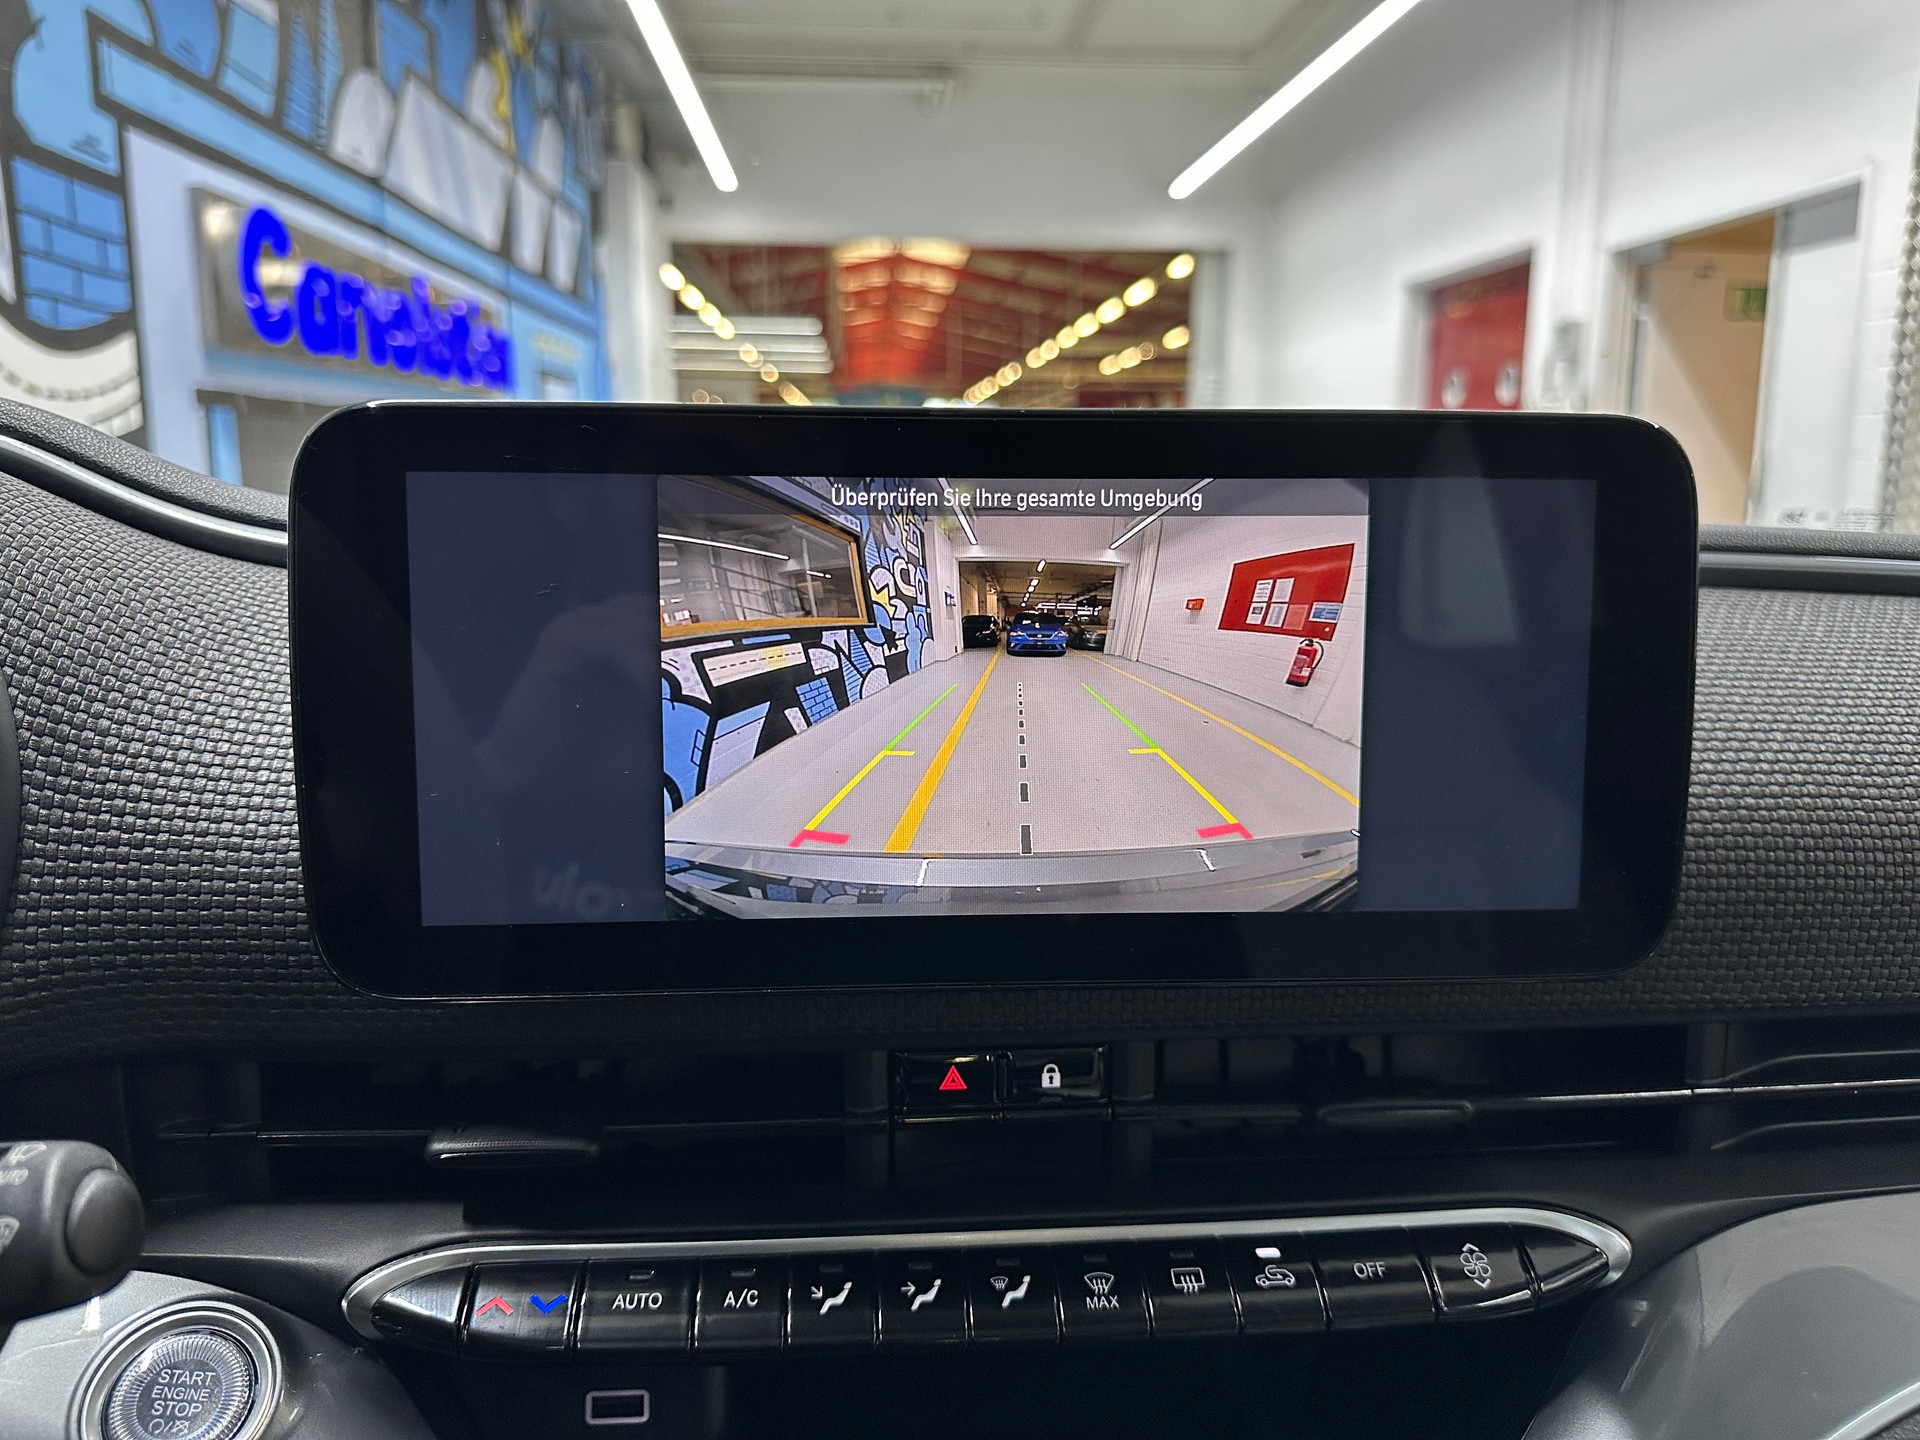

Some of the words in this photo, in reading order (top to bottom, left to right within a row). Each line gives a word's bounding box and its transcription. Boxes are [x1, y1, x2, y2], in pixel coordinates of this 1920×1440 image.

[831, 484, 938, 511] Überprüfen
[943, 487, 971, 508] Sie
[976, 487, 1012, 508] Ihre
[1016, 488, 1096, 511] gesamte
[1100, 488, 1204, 511] Umgebung
[1353, 1260, 1387, 1280] OFF
[611, 1291, 663, 1311] AUTO
[723, 1287, 759, 1310] A/C
[1086, 1295, 1120, 1310] MAX
[158, 1368, 217, 1386] START
[151, 1385, 211, 1402] ENGINE
[151, 1400, 203, 1417] STOP
